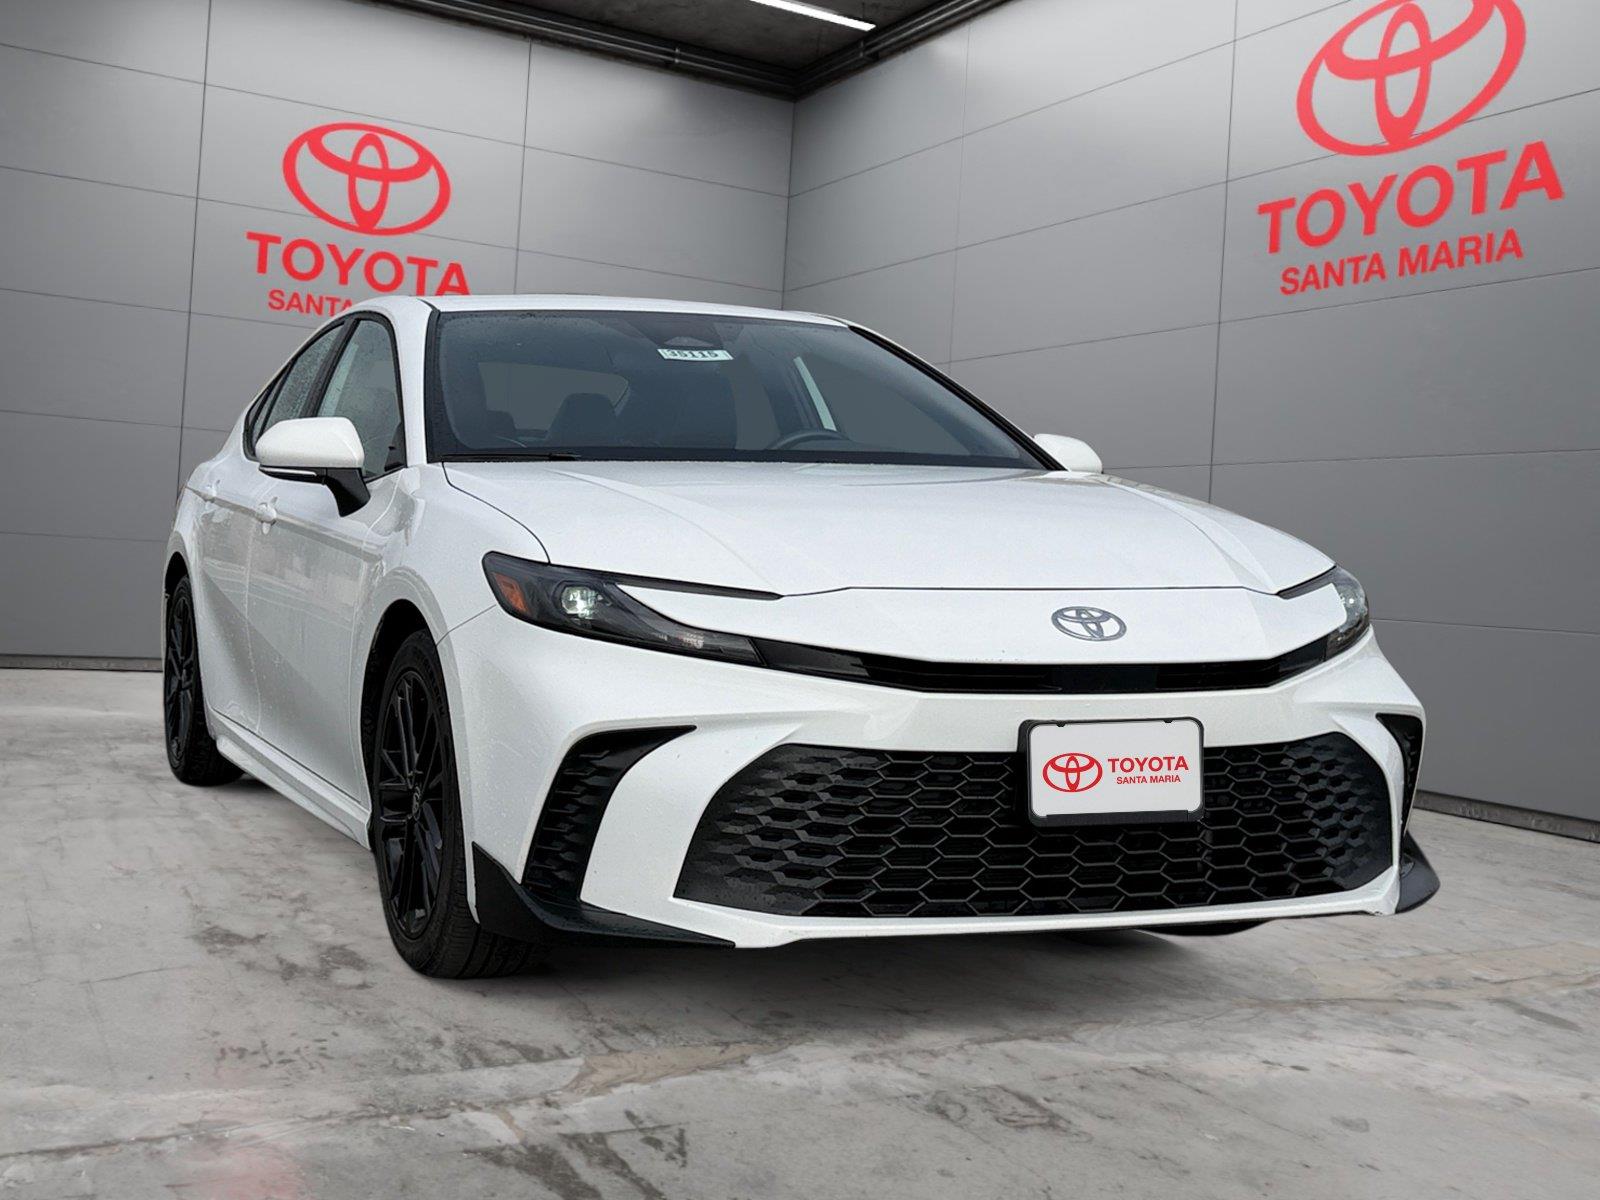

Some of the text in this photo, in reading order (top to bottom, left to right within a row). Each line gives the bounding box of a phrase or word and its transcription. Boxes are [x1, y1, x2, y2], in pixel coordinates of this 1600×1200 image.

[1256, 140, 1565, 254] TOYOTA
[245, 231, 471, 297] TOYOTA
[1279, 228, 1524, 297] SANTA MARIA
[1107, 755, 1189, 773] TOYOTA
[1116, 774, 1181, 785] SANTA MARIA
